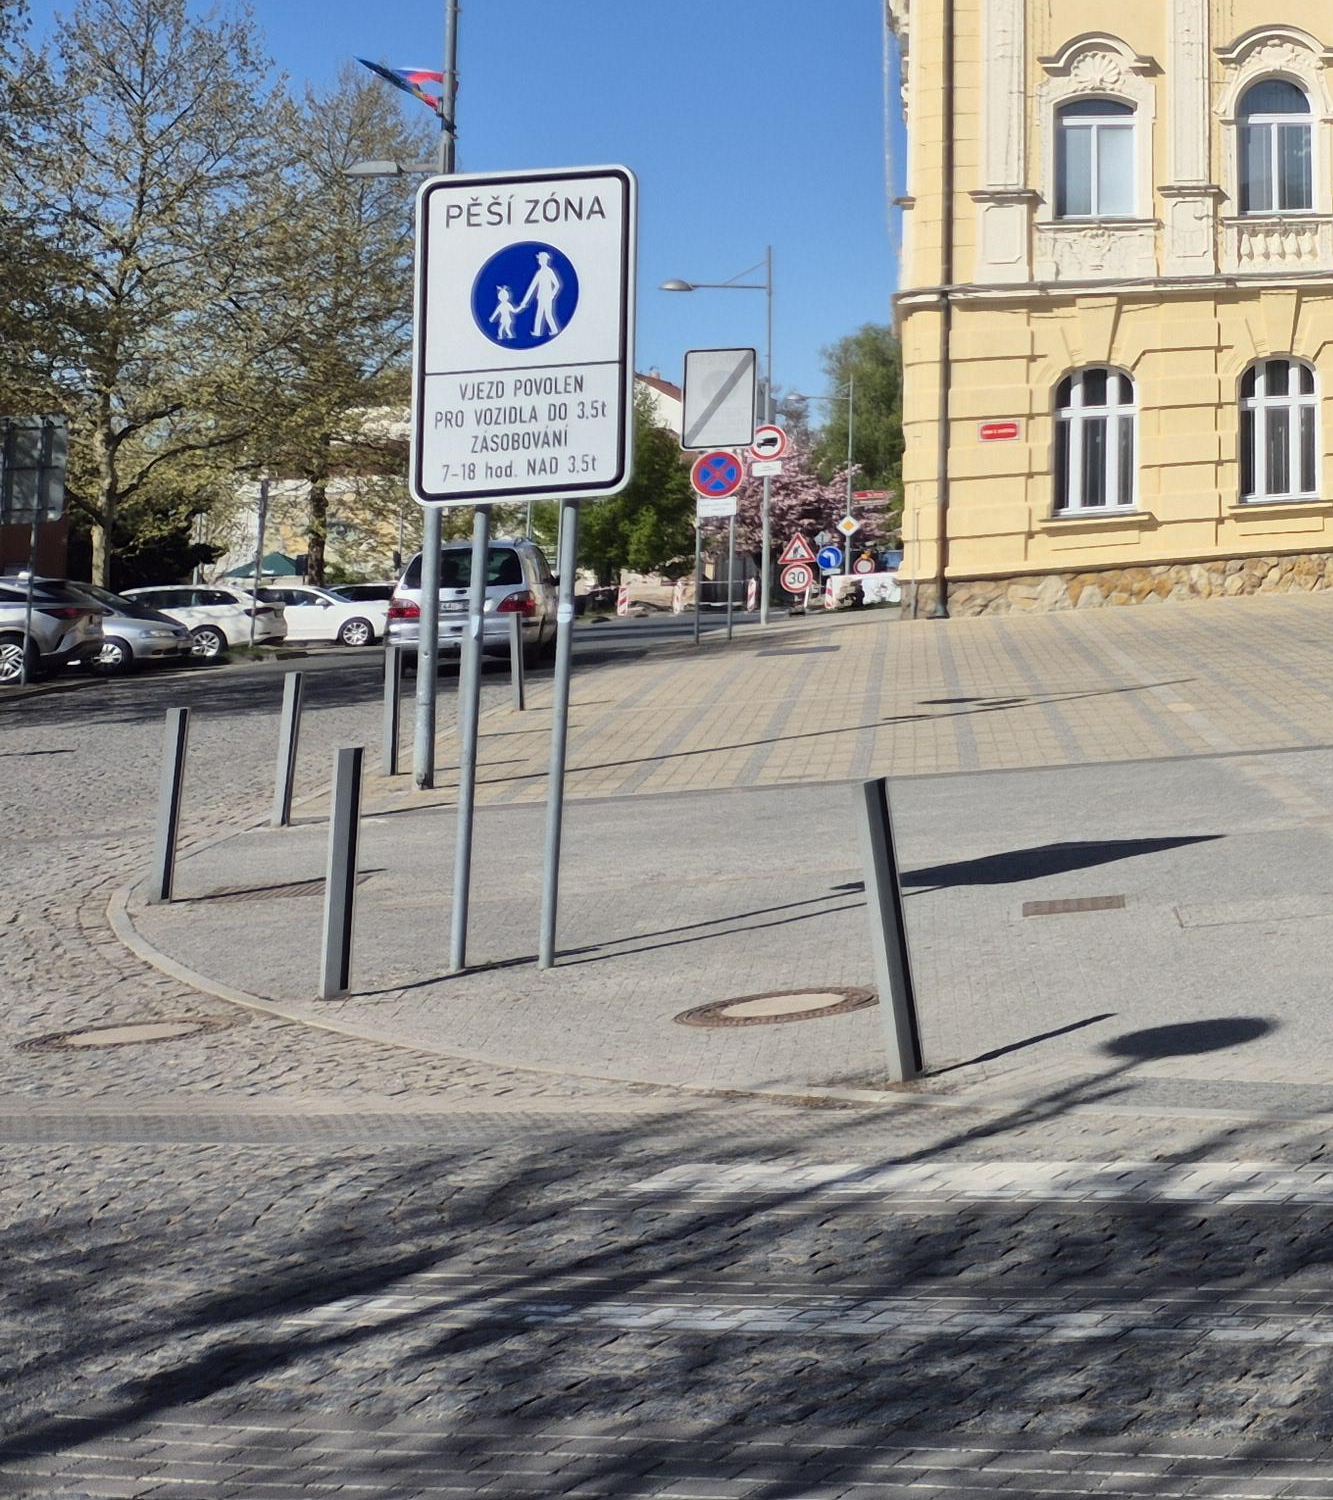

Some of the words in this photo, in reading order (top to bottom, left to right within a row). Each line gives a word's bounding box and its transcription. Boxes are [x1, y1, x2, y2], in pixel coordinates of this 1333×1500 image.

[445, 194, 515, 229] PĚŠÍ
[523, 192, 607, 225] ZÓNA
[459, 380, 505, 401] VJEZD
[513, 374, 585, 398] POVOLEN
[434, 410, 465, 429] PRO
[474, 404, 538, 428] VOZIDLA
[547, 403, 568, 422] DO
[471, 424, 569, 454] ZÁSOBOVÁNÍ
[442, 462, 477, 483] 7-18
[485, 460, 518, 480] hod.
[526, 457, 559, 477] NAD
[788, 571, 805, 585] 30
